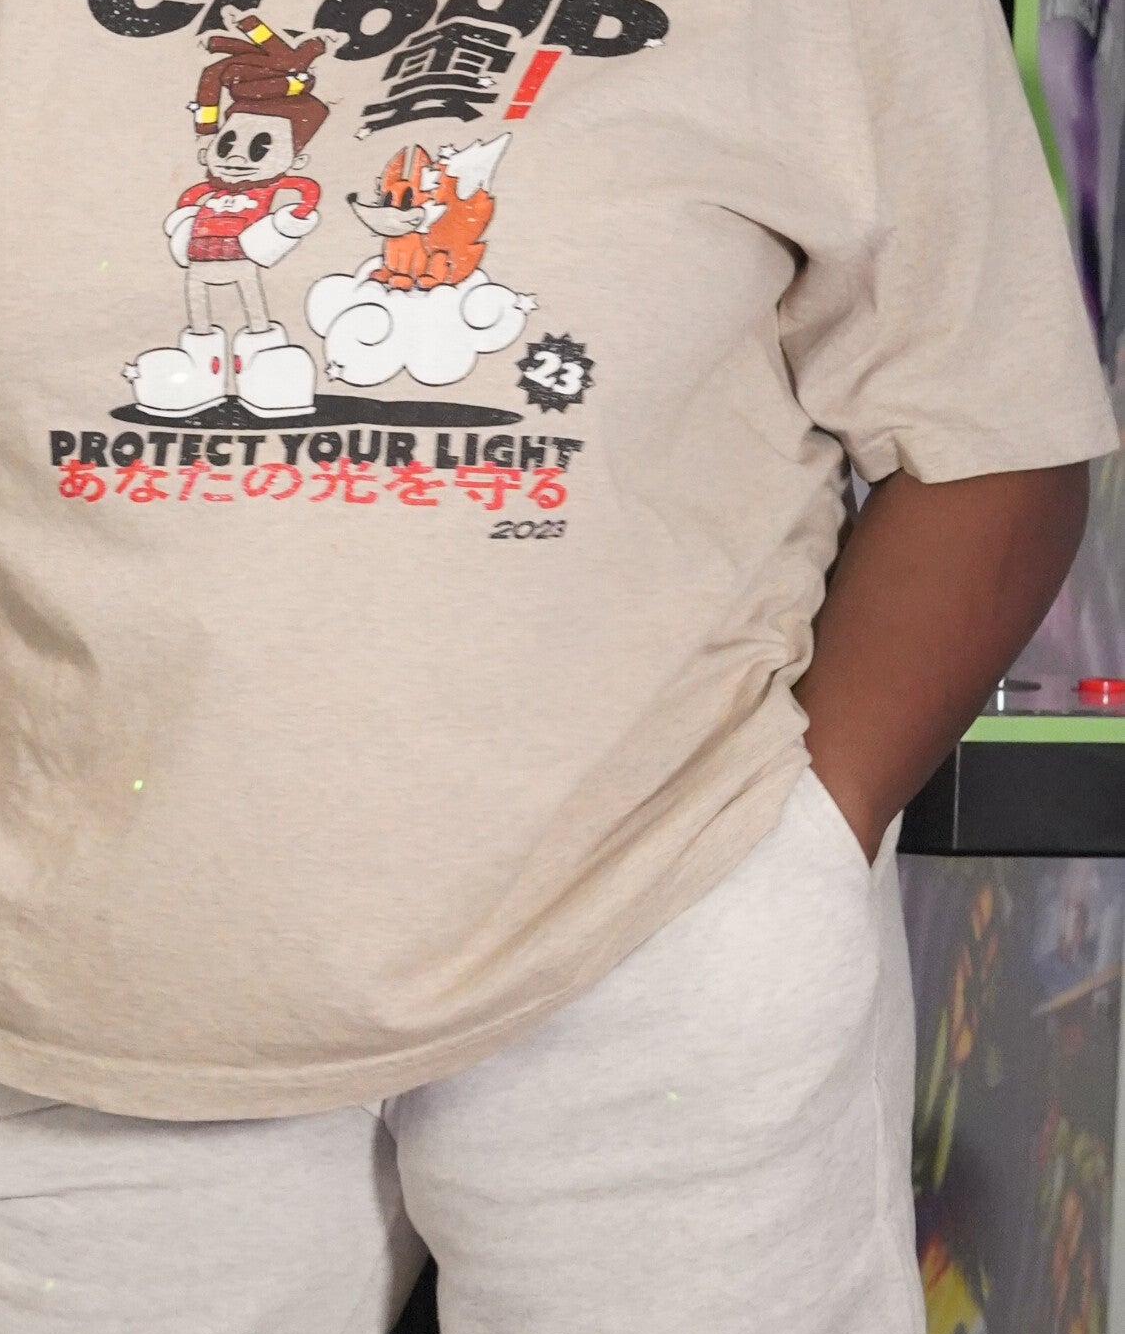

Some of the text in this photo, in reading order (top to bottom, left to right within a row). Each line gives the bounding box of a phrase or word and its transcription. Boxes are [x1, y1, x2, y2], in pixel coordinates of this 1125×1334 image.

[523, 351, 585, 395] 23
[49, 429, 585, 473] PROTECT YOUR LIGHT
[58, 457, 567, 510] あなたの光を守る
[489, 520, 567, 540] 2023
